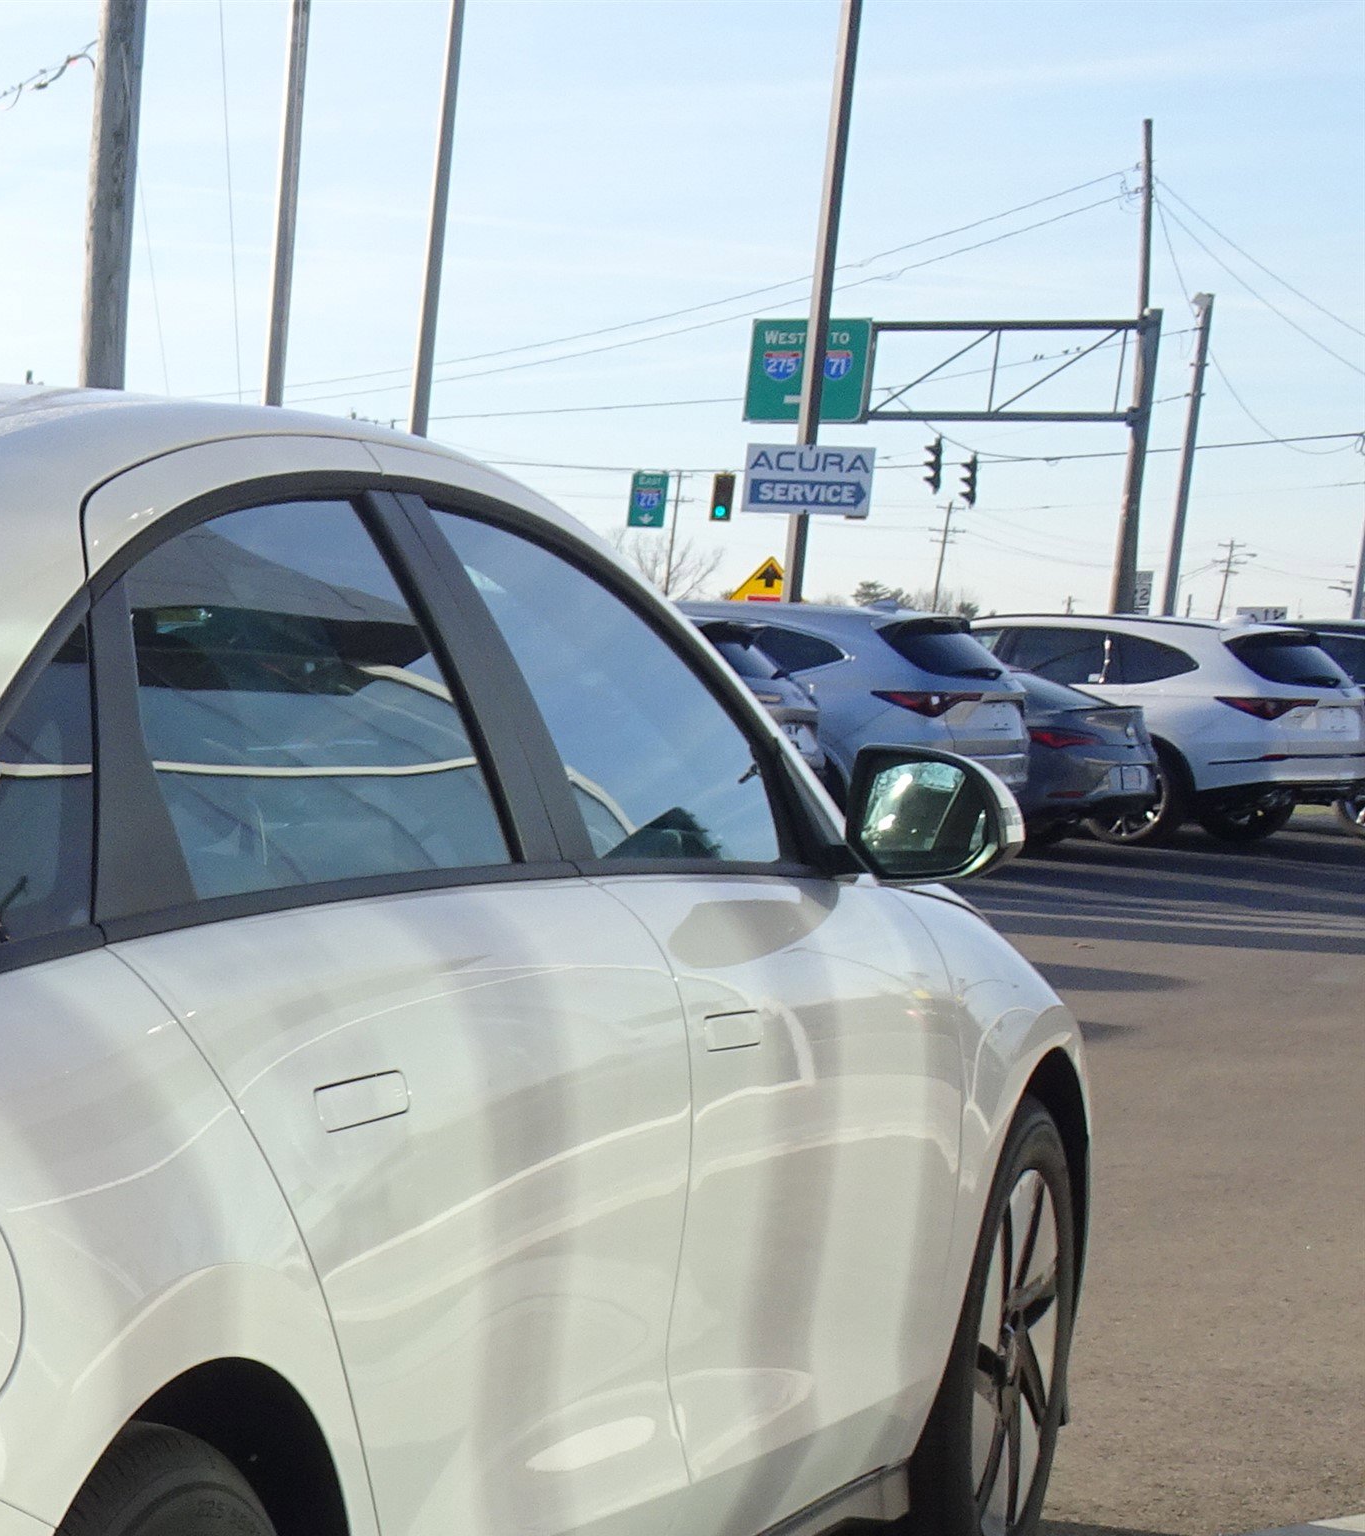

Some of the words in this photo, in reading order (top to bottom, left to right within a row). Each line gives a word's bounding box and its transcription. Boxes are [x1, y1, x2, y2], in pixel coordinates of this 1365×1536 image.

[765, 330, 806, 345] WEST
[831, 332, 850, 345] TO
[767, 359, 796, 373] 275
[829, 359, 847, 375] 71
[750, 450, 870, 474] ACURA
[758, 481, 857, 504] SERVICE
